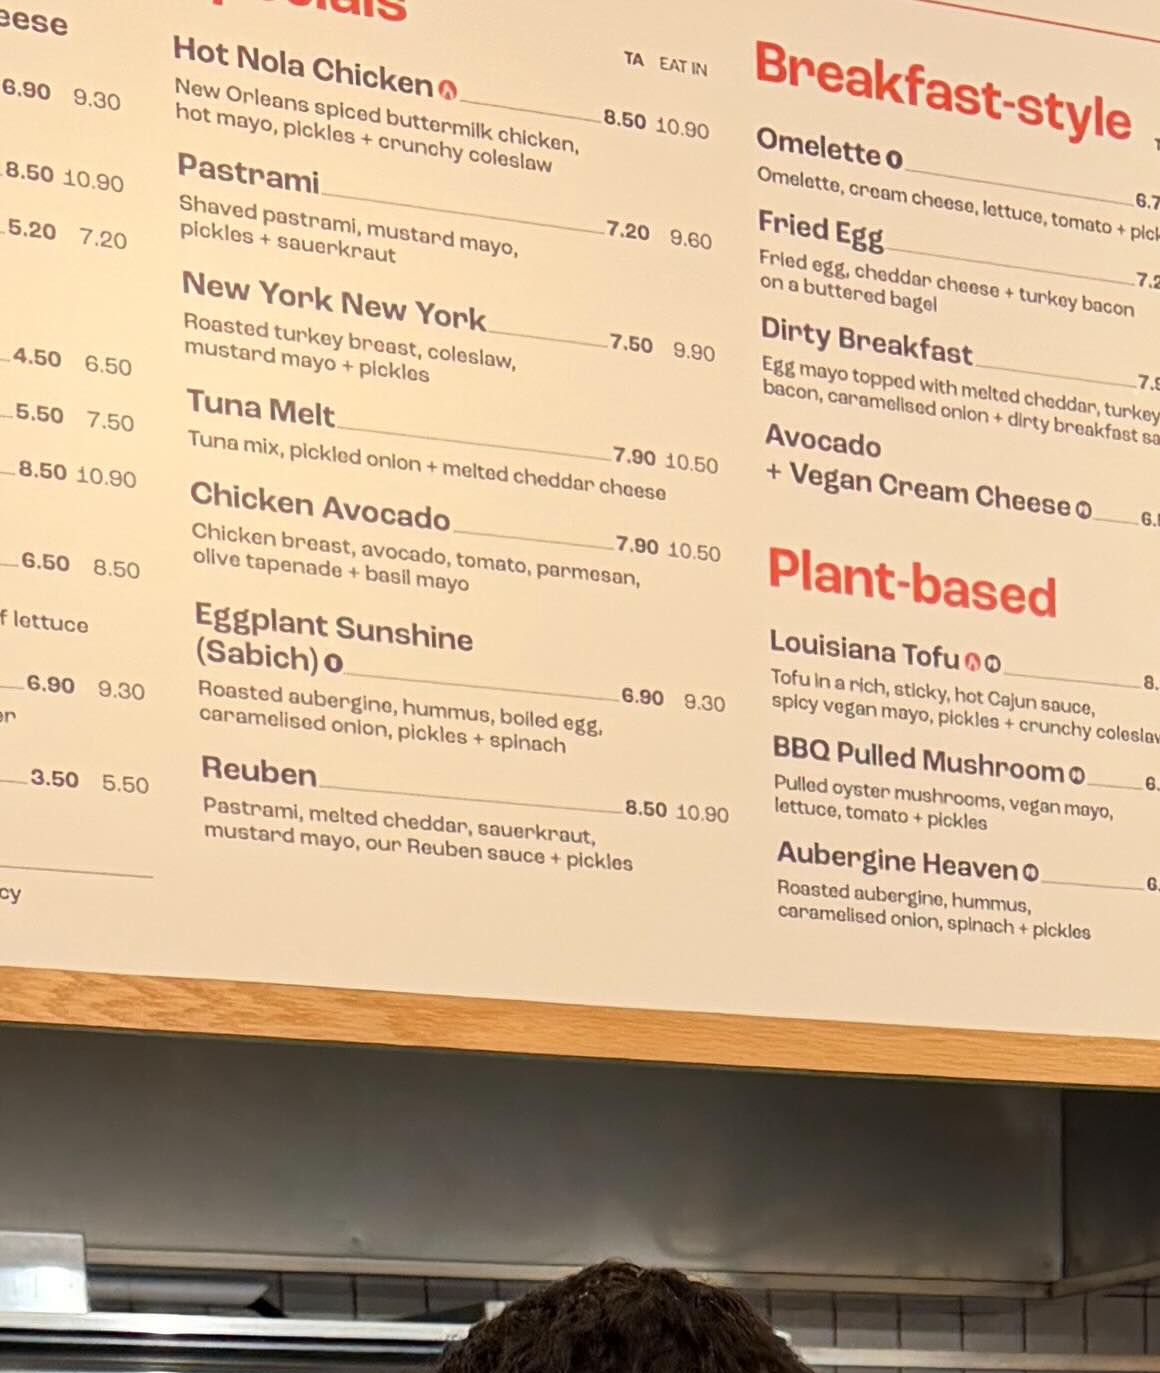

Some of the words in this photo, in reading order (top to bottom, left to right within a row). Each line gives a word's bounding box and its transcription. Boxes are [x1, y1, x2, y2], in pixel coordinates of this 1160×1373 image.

[174, 35, 229, 66] Hot
[237, 45, 304, 77] Nola
[313, 58, 433, 97] Chicken
[624, 50, 644, 66] TA
[660, 56, 688, 73] EAT
[692, 62, 708, 76] IN
[2, 78, 50, 100] 6.90
[74, 88, 120, 111] 9.30
[756, 40, 1132, 144] Breakfast-style
[176, 102, 211, 123] hot
[217, 112, 278, 136] mayo,
[284, 120, 355, 144] pickles
[378, 136, 464, 164] crunchy
[469, 149, 552, 172] coleslaw
[604, 109, 646, 130] 8.50
[656, 117, 709, 140] 10.90
[757, 127, 880, 166] Omelette
[178, 152, 318, 194] Pastrami
[8, 218, 56, 240] 5.20
[80, 228, 127, 250] 7.20
[606, 220, 650, 240] 7.20
[670, 229, 712, 250] 9.60
[759, 209, 828, 240] Fried
[836, 220, 884, 254] Egg
[183, 270, 250, 300] New
[258, 280, 333, 312] York
[342, 292, 406, 321] New
[415, 300, 487, 332] York
[610, 333, 653, 354] 7.50
[674, 342, 715, 362] 9.90
[762, 316, 830, 352] Dirty
[839, 326, 973, 366] Breakfast
[186, 388, 261, 419] Tuna
[270, 398, 336, 428] Melt
[613, 446, 656, 466] 7.90
[666, 452, 718, 474] 10.50
[766, 424, 881, 458] Avocado
[190, 482, 314, 516] Chicken
[322, 496, 450, 531] Avocado
[789, 461, 872, 494] Vegan
[879, 473, 968, 504] Cream
[976, 485, 1070, 516] Cheese
[616, 535, 658, 554] 7.90
[668, 542, 720, 562] 10.50
[770, 546, 1056, 618] Plant-based
[196, 602, 328, 637] Eggplant
[336, 616, 472, 652] Sunshine
[197, 636, 318, 676] (Sabich)
[770, 628, 896, 663] Louisiana
[902, 643, 959, 670] Tofu
[622, 688, 664, 706] 6.90
[684, 694, 726, 712] 9.30
[202, 755, 316, 788] Reuben
[774, 735, 830, 762] BBQ
[838, 741, 916, 768] Pulled
[924, 750, 1064, 783] Mushroom
[31, 768, 78, 788] 3.50
[102, 774, 149, 794] 5.50
[626, 800, 667, 818] 8.50
[676, 804, 728, 824] 10.90
[775, 796, 842, 820] lettuce,
[846, 806, 908, 824] tomato
[928, 812, 988, 830] pickles
[777, 840, 916, 876] Aubergine
[923, 852, 1018, 880] Heaven
